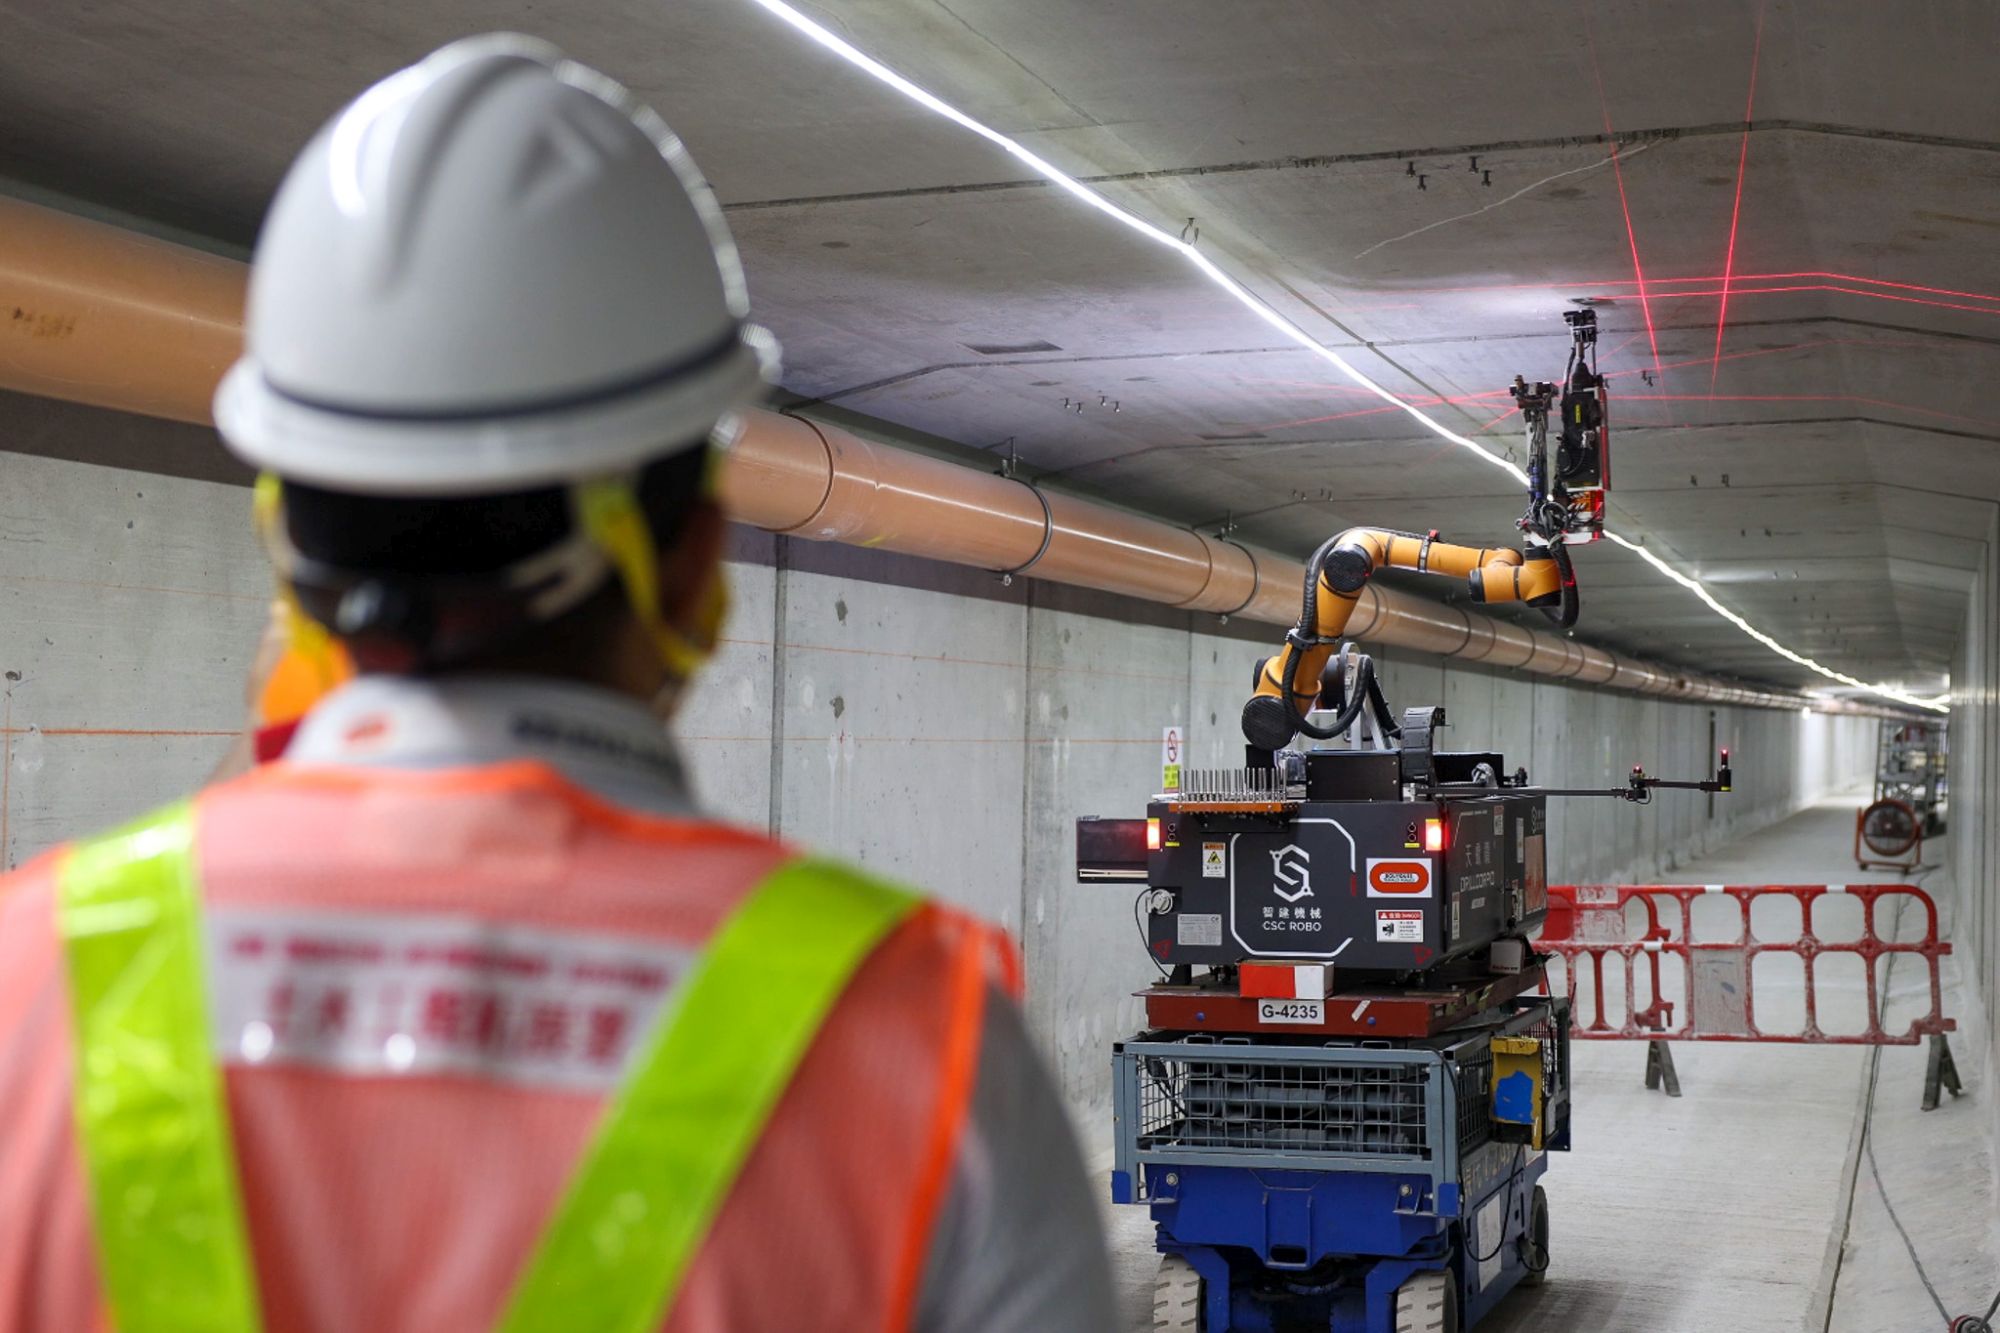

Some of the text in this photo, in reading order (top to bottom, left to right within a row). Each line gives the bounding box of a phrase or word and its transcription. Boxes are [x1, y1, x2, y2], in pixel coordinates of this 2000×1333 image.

[1262, 920, 1322, 932] CSC ROBO
[1262, 1004, 1318, 1019] G-4235
